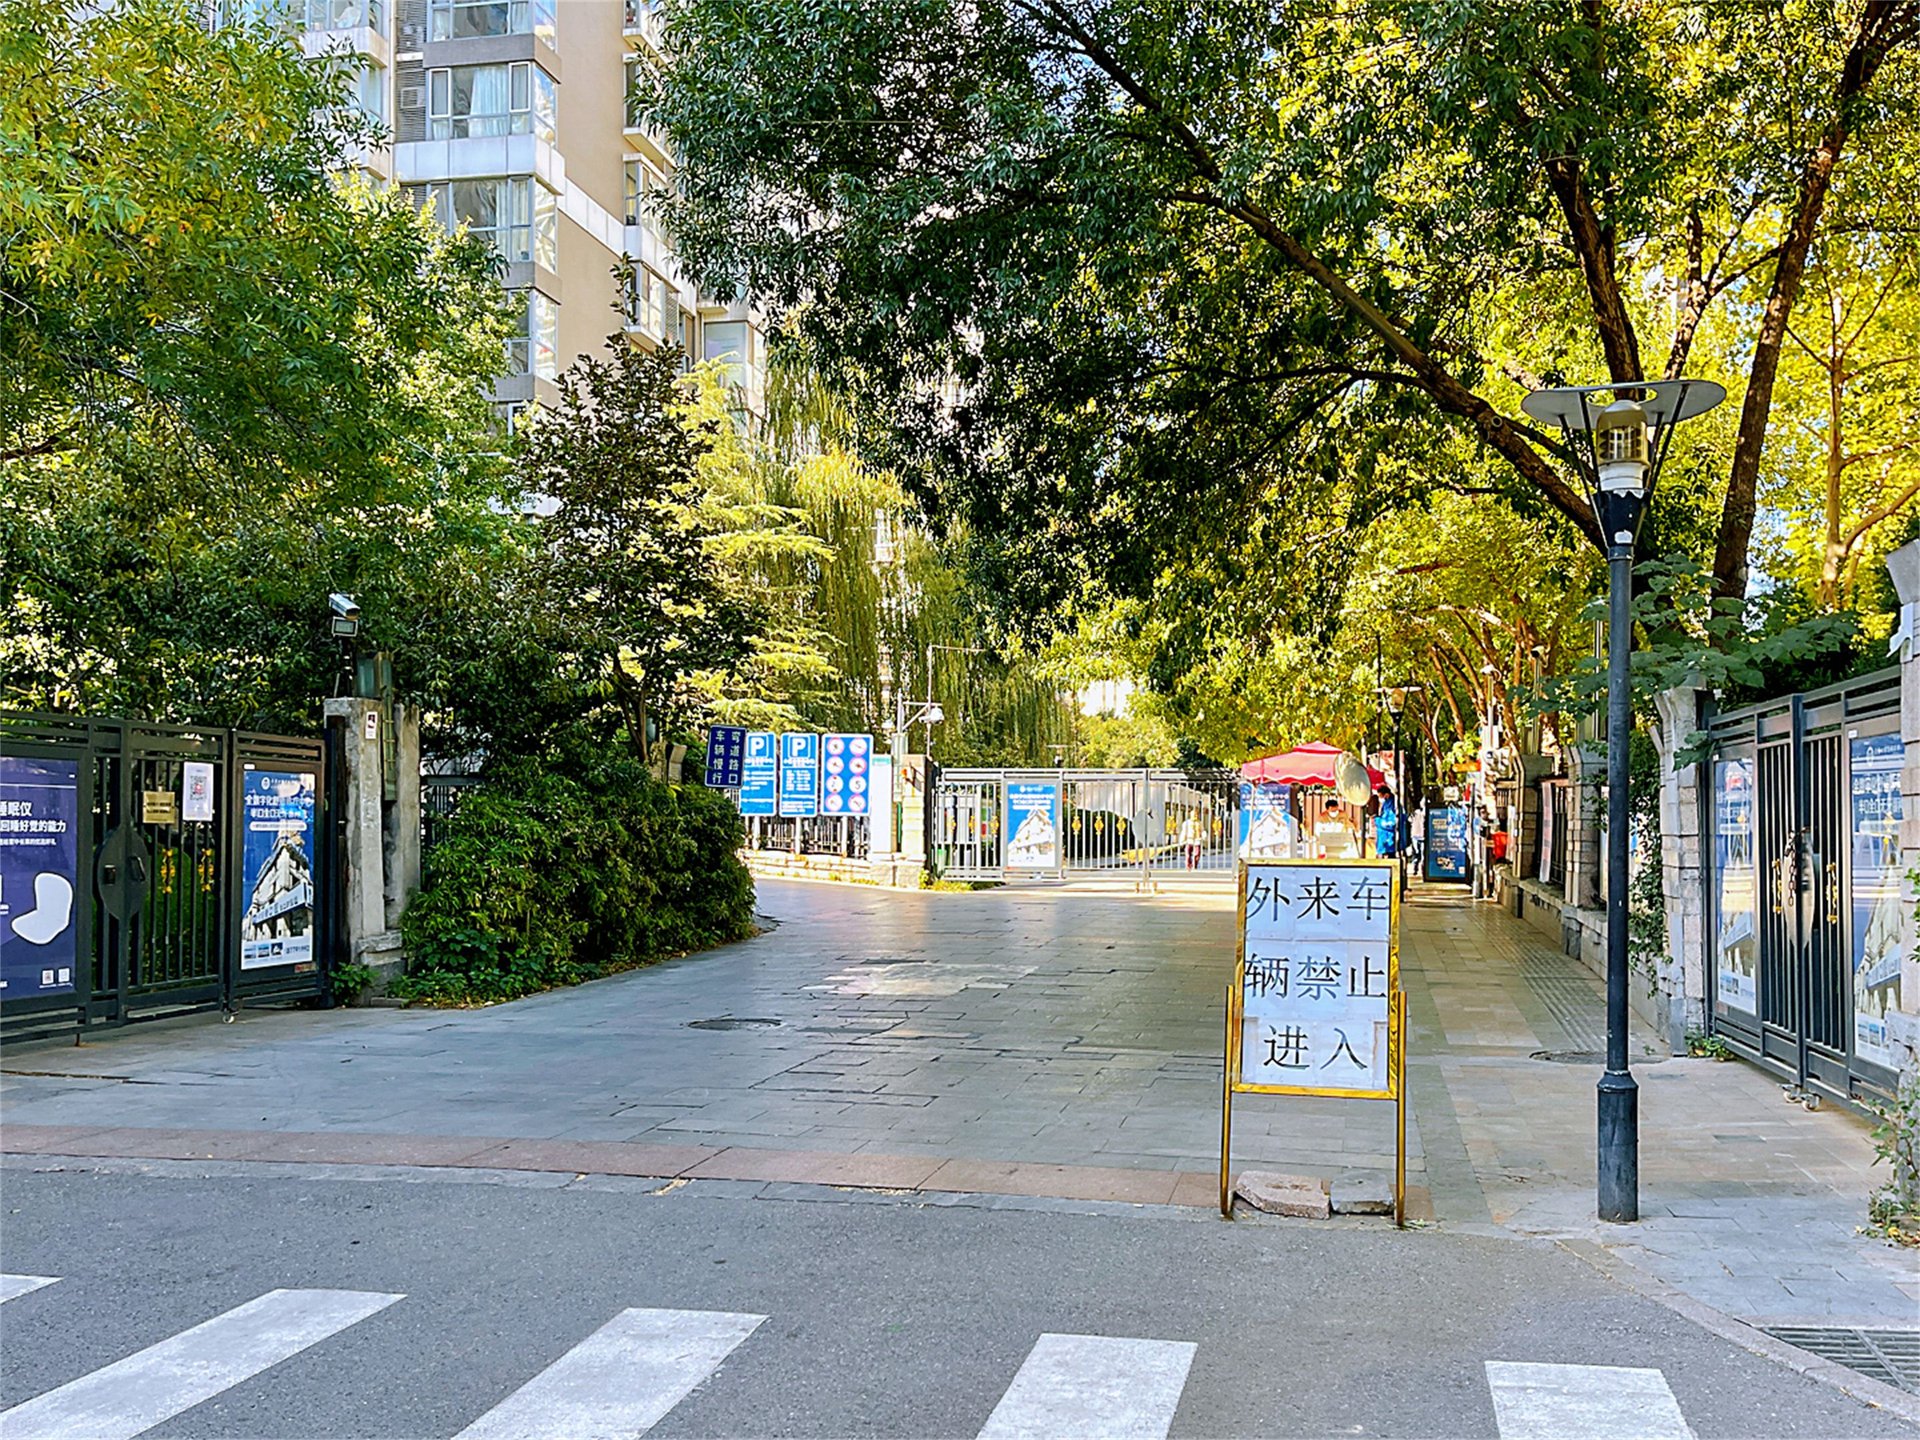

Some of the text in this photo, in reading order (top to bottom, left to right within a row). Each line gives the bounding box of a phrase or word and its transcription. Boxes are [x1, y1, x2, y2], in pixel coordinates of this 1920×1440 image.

[712, 729, 726, 784] 车辆慢行
[728, 730, 741, 784] 弯道路口
[750, 737, 765, 756] P
[792, 737, 806, 757] P
[0, 819, 67, 833] 回睡好觉的能力
[1245, 876, 1390, 922] 外来车
[1244, 953, 1388, 1001] 辆禁止
[1263, 1024, 1369, 1071] 进入
